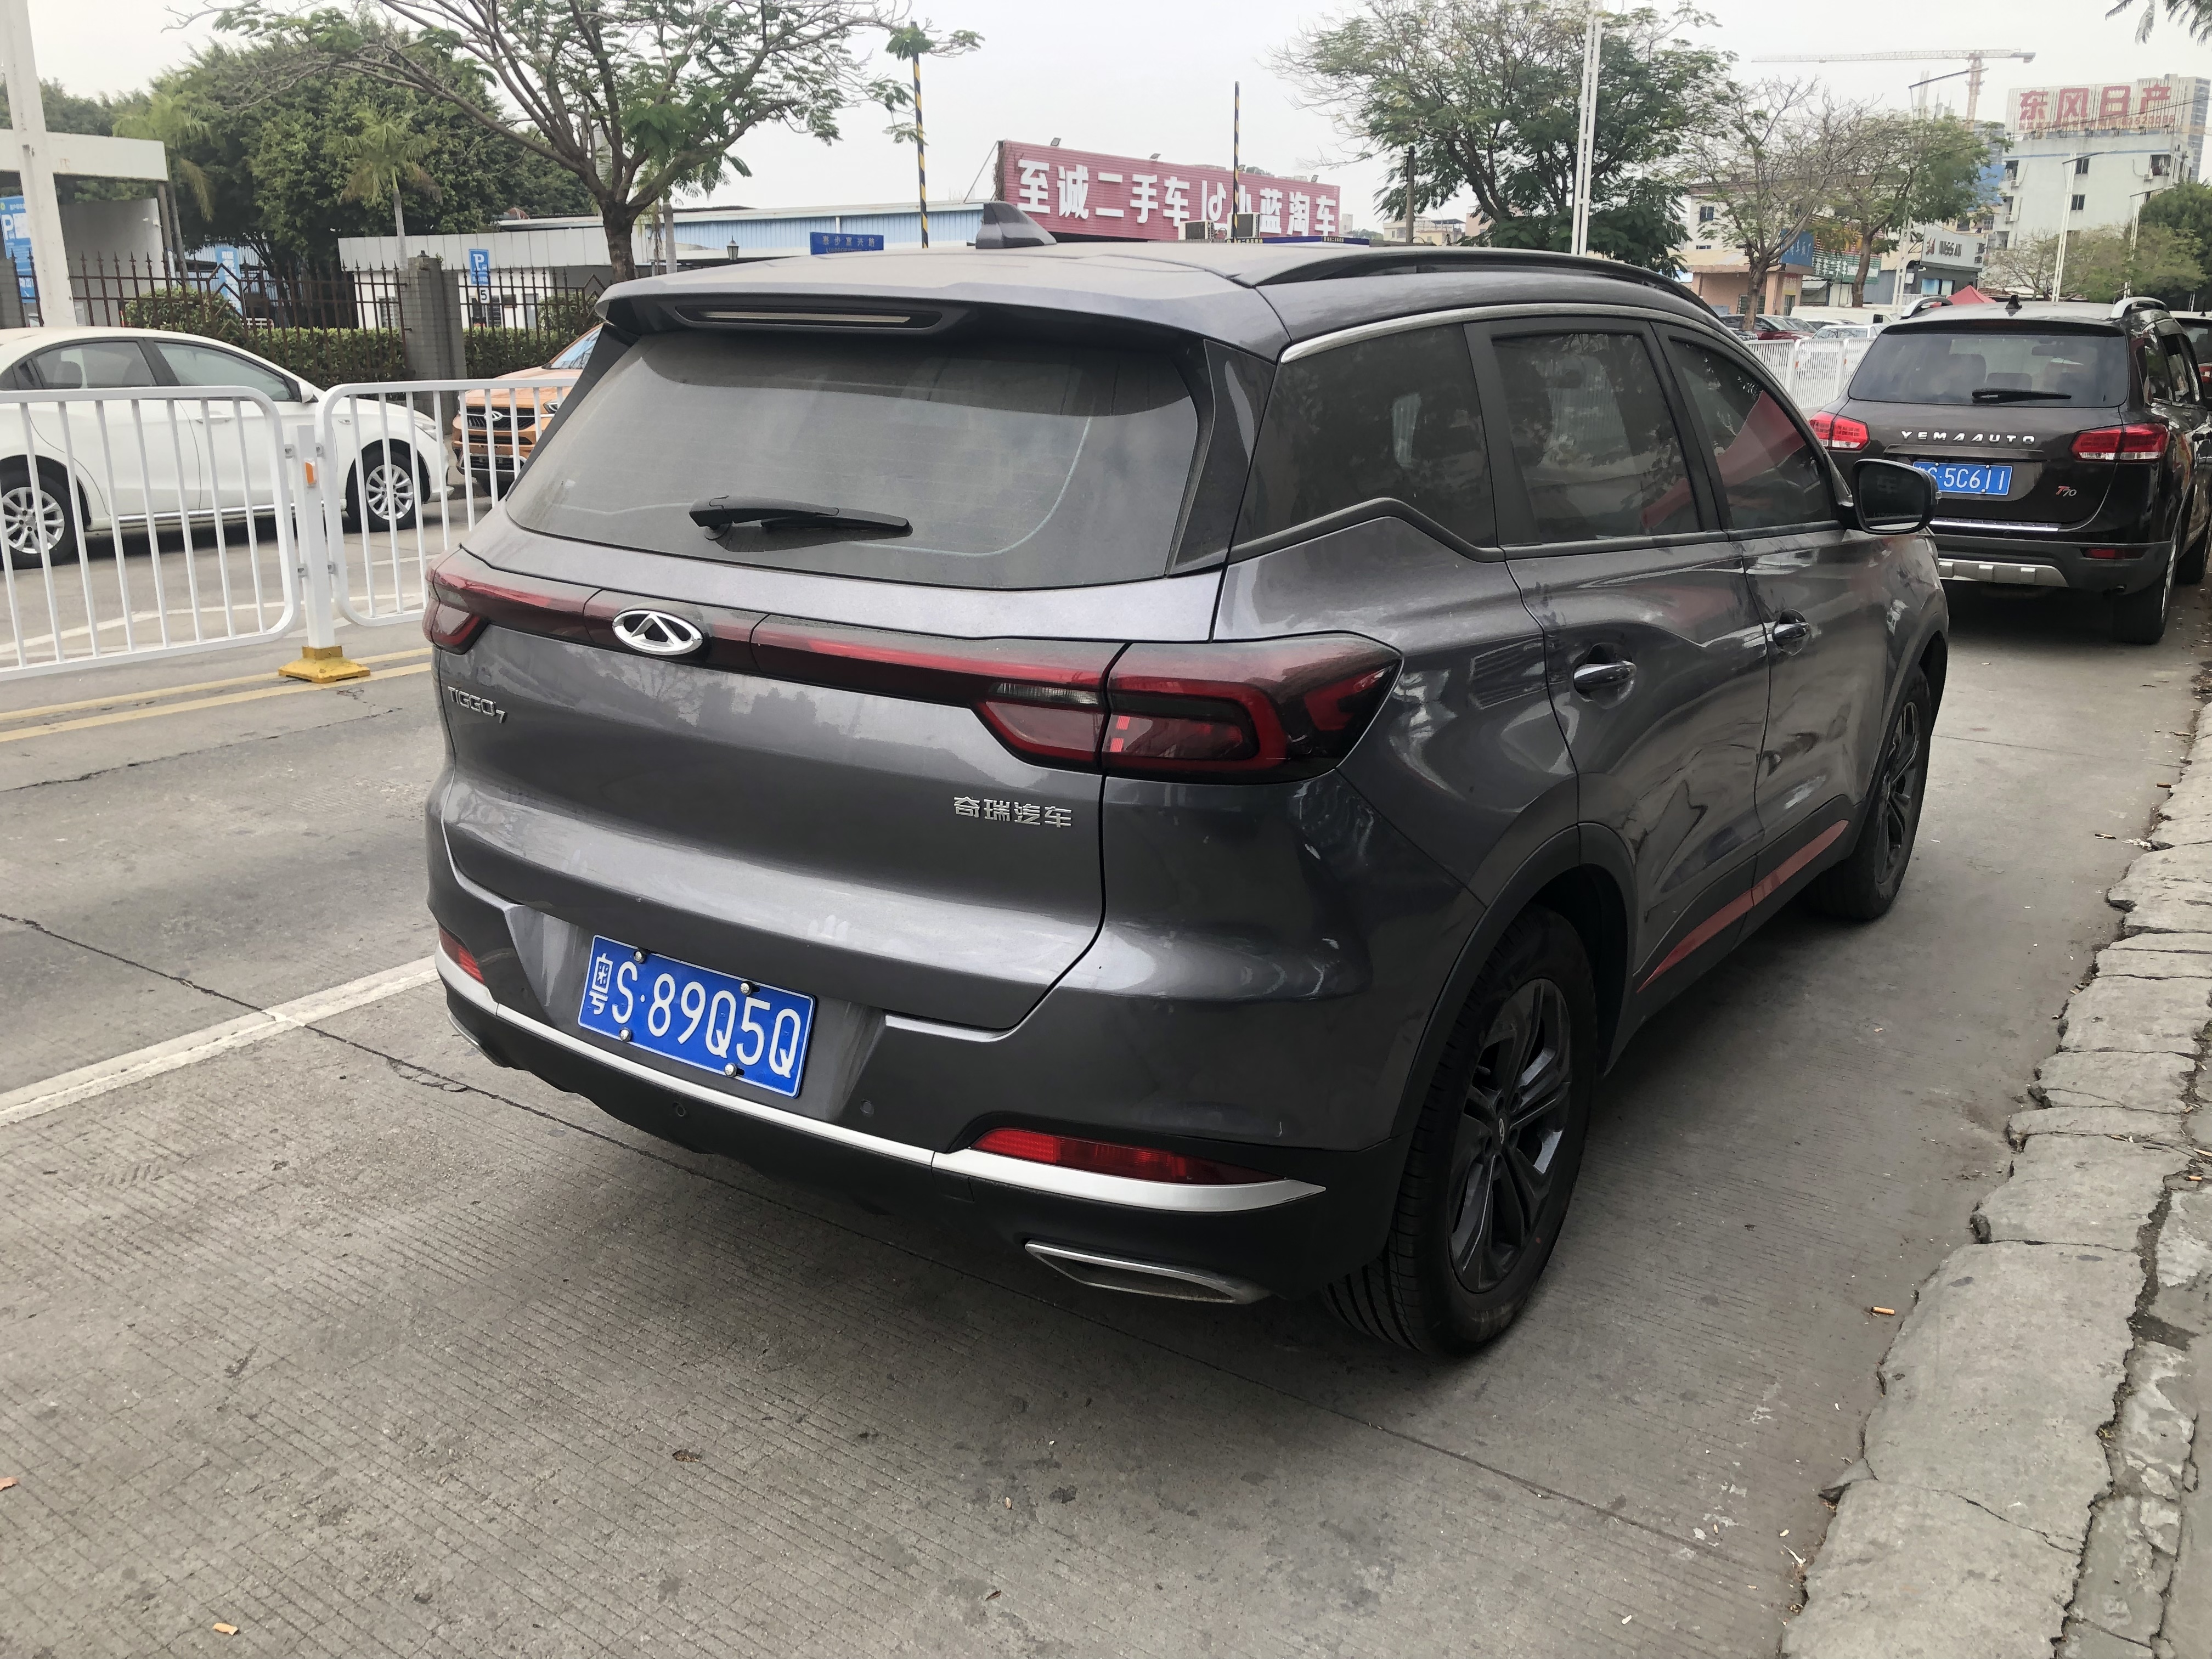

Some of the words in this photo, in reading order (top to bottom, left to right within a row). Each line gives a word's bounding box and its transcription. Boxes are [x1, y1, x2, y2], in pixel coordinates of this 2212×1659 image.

[2019, 84, 2171, 122] 东风日产
[1017, 159, 1190, 227] 至诚二手车
[473, 254, 485, 271] P
[481, 290, 488, 301] 5
[2056, 486, 2077, 497] T70
[953, 796, 1072, 828] 奇瑞汽车
